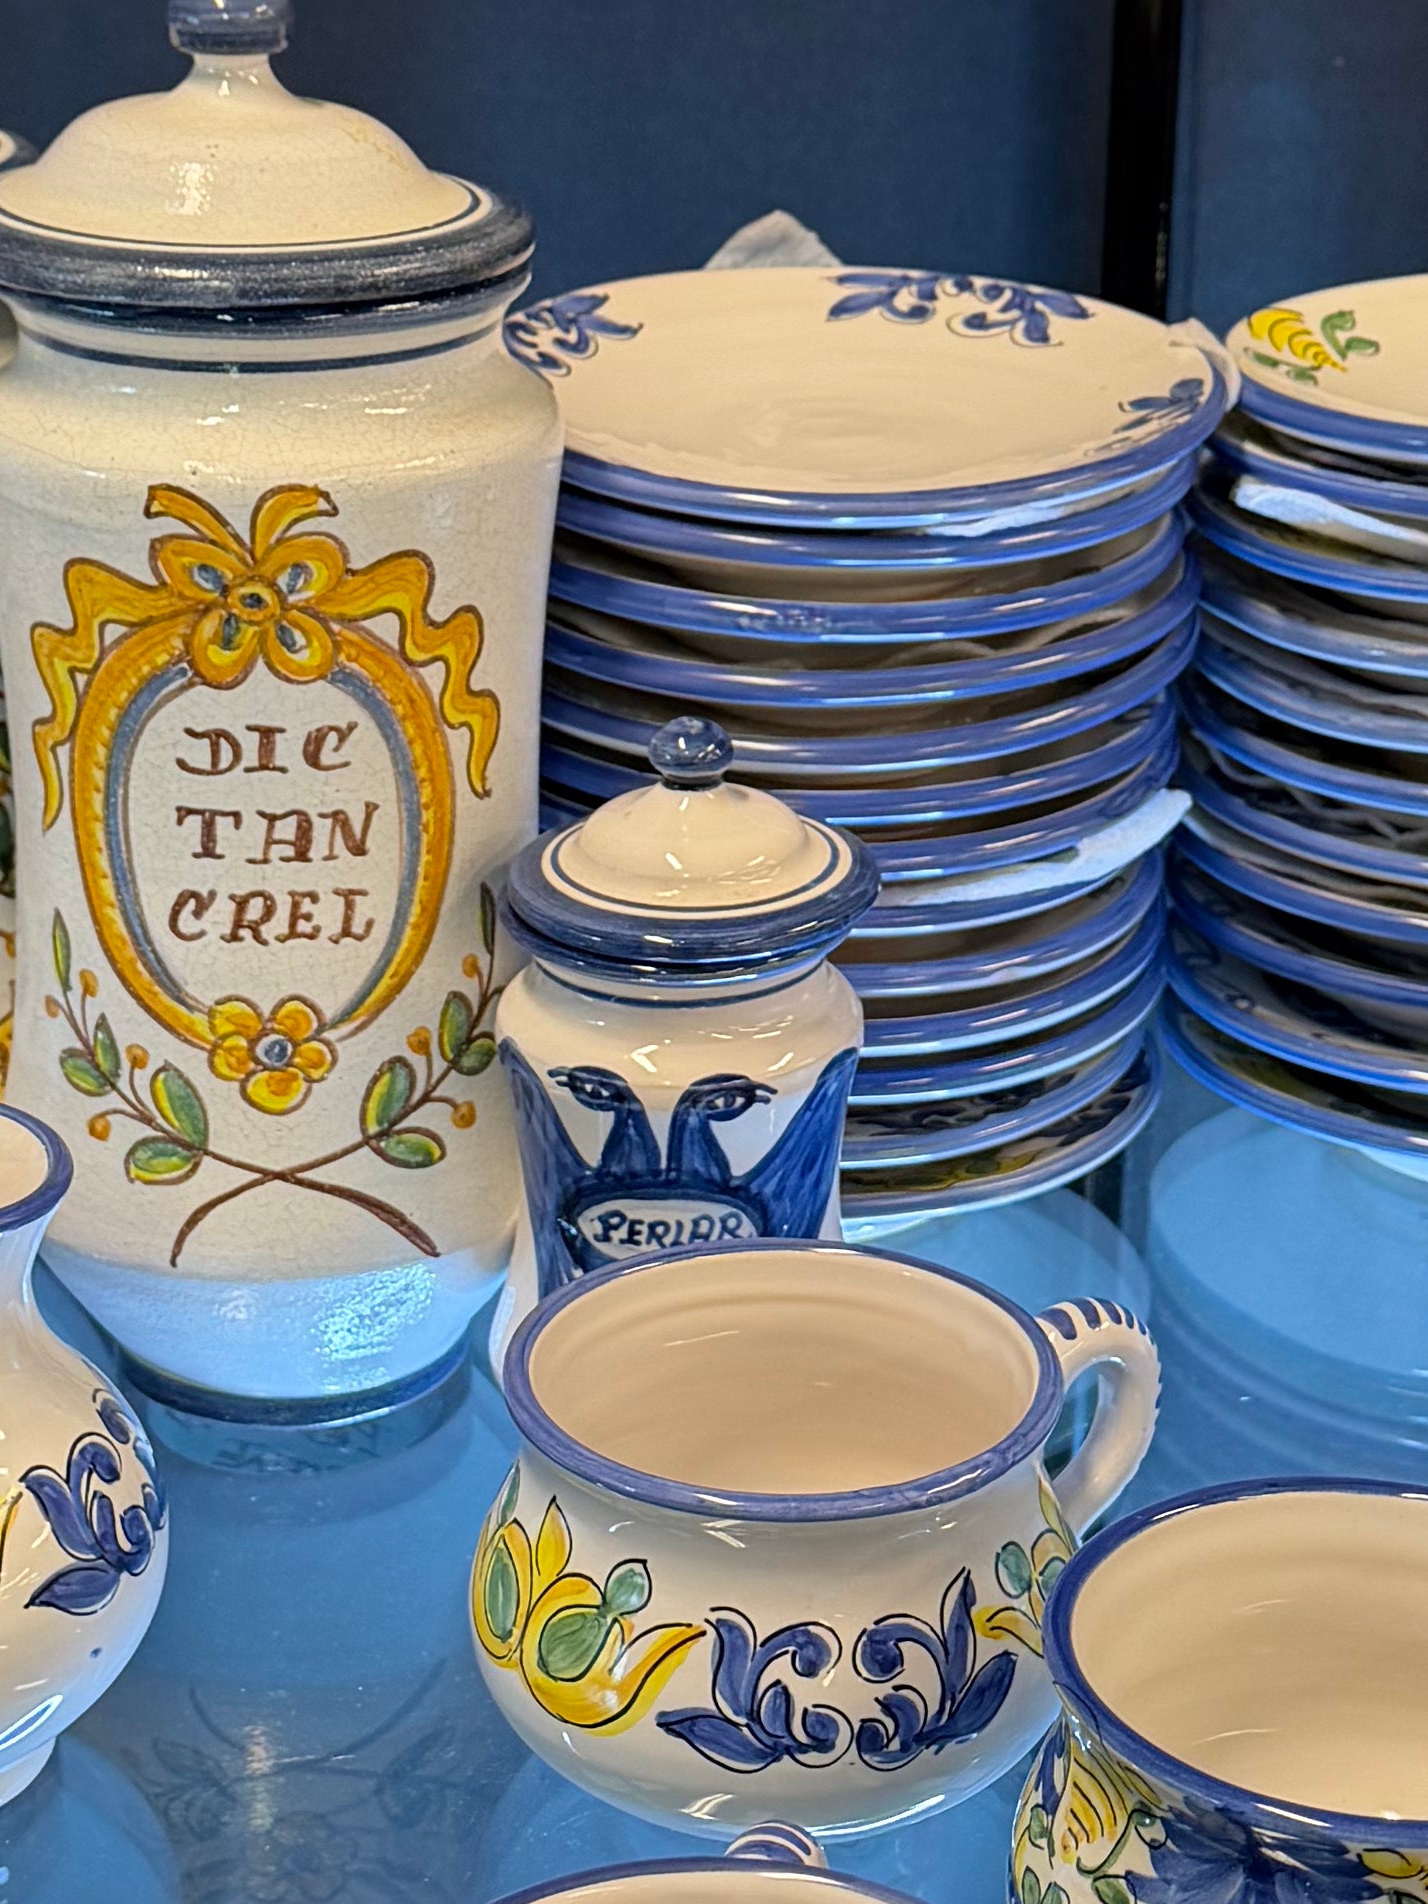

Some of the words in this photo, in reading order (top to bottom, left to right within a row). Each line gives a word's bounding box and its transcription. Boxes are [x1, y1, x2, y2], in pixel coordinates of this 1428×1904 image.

[175, 720, 359, 777] DIC
[175, 800, 380, 865] TAN
[168, 888, 375, 946] CREL
